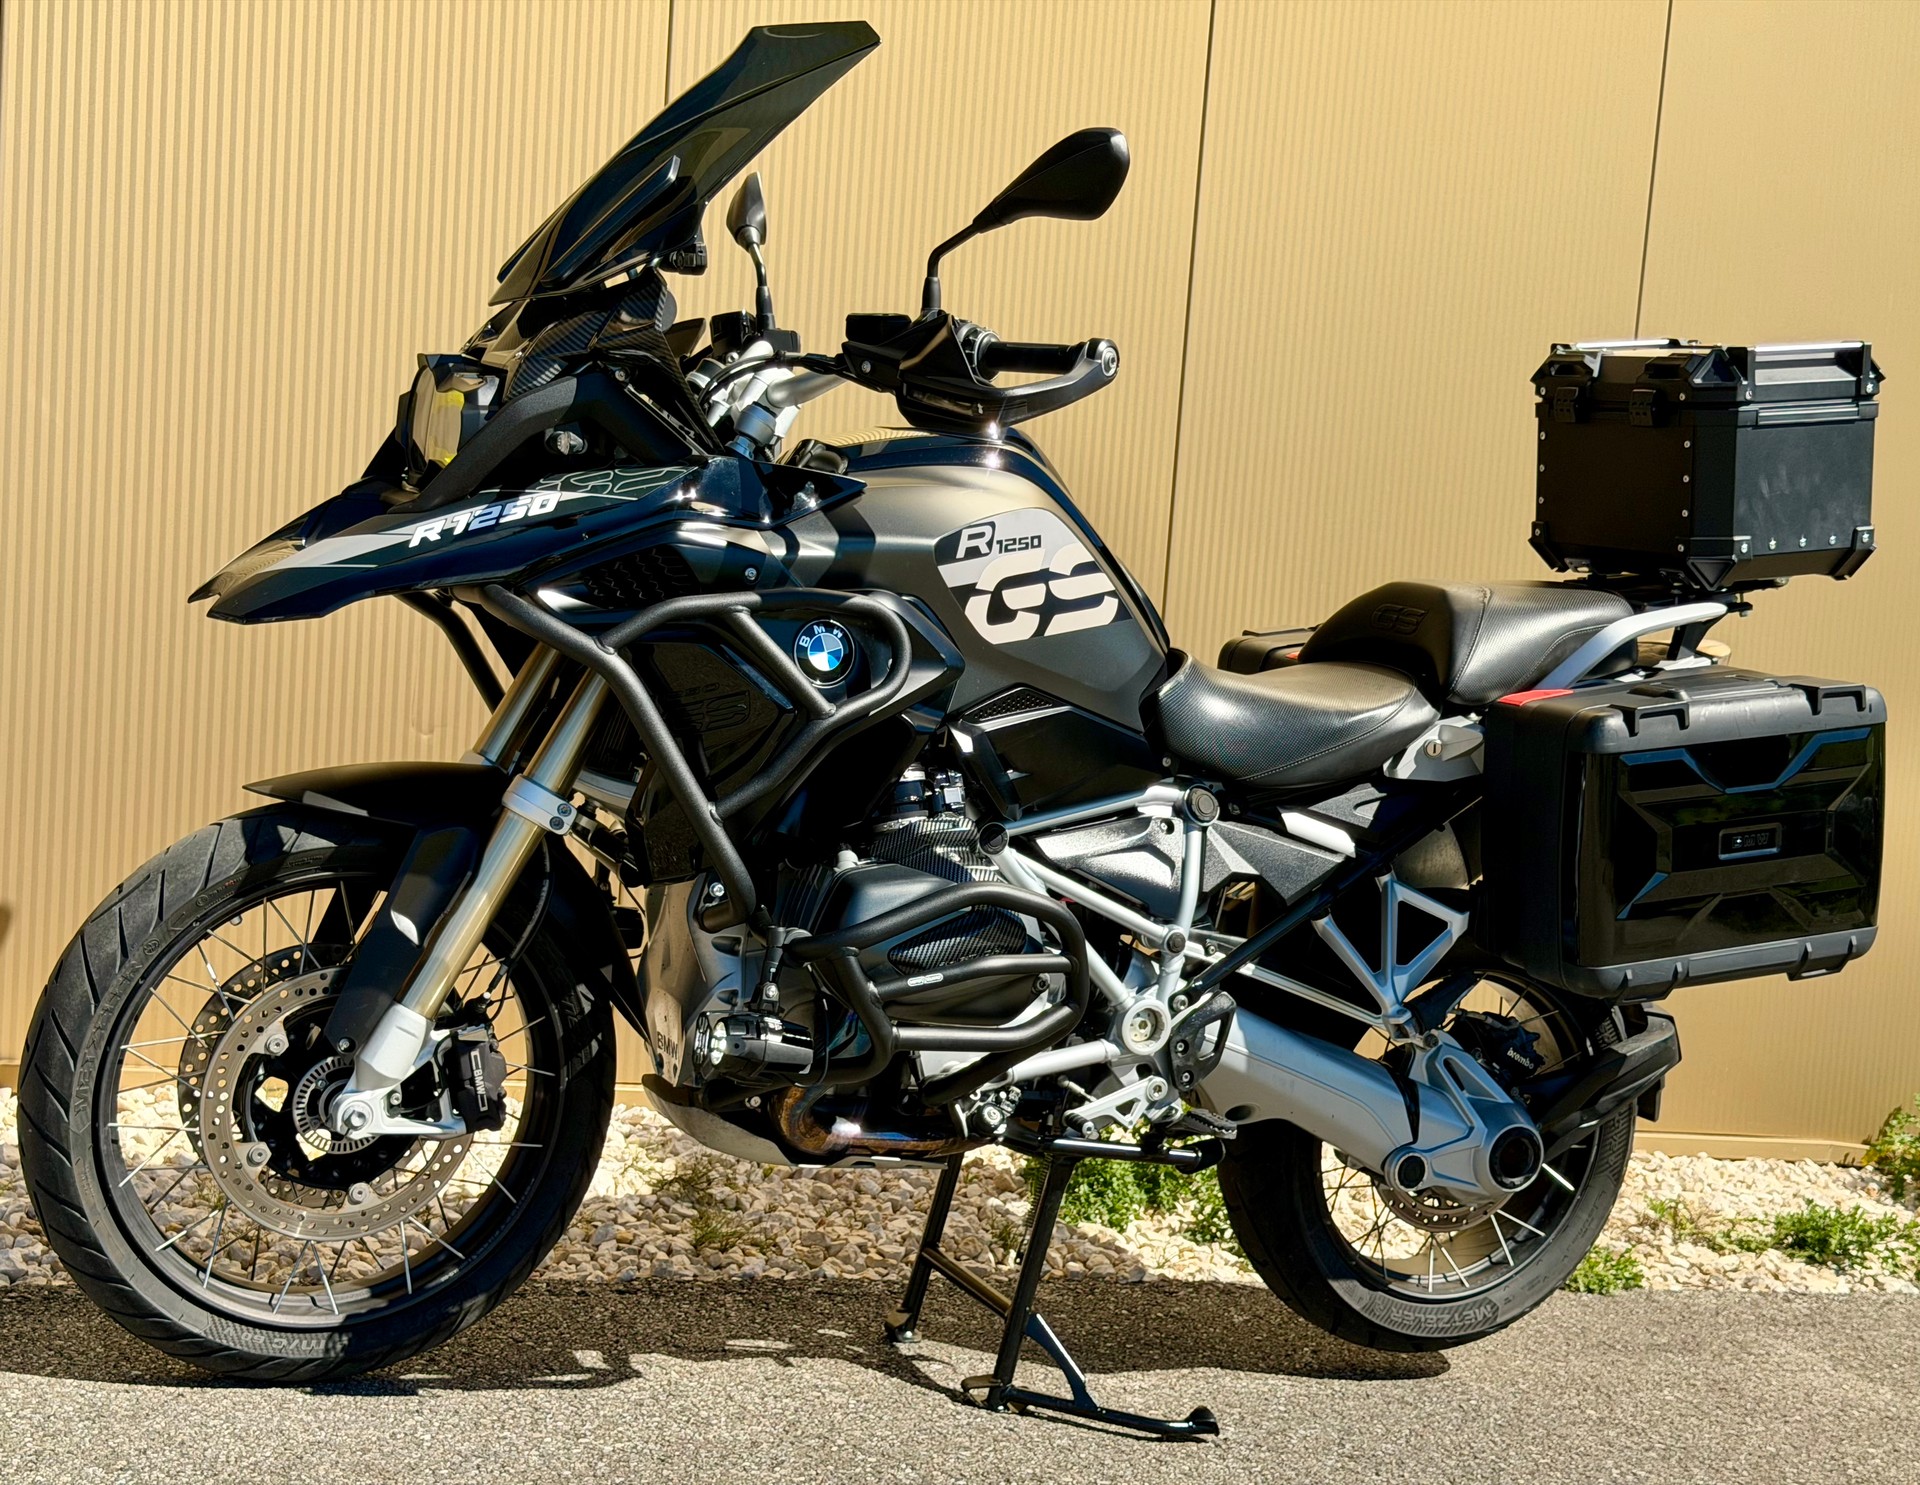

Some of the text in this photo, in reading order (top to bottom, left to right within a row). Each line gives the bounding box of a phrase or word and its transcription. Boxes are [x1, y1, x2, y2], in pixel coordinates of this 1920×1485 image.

[955, 524, 1042, 560] R 1250
[964, 541, 1119, 645] GS
[798, 624, 844, 648] BMW
[657, 1031, 678, 1060] BMW
[1507, 1047, 1534, 1069] brembo
[473, 1069, 487, 1095] BMW
[1390, 1303, 1495, 1328] METZELER
